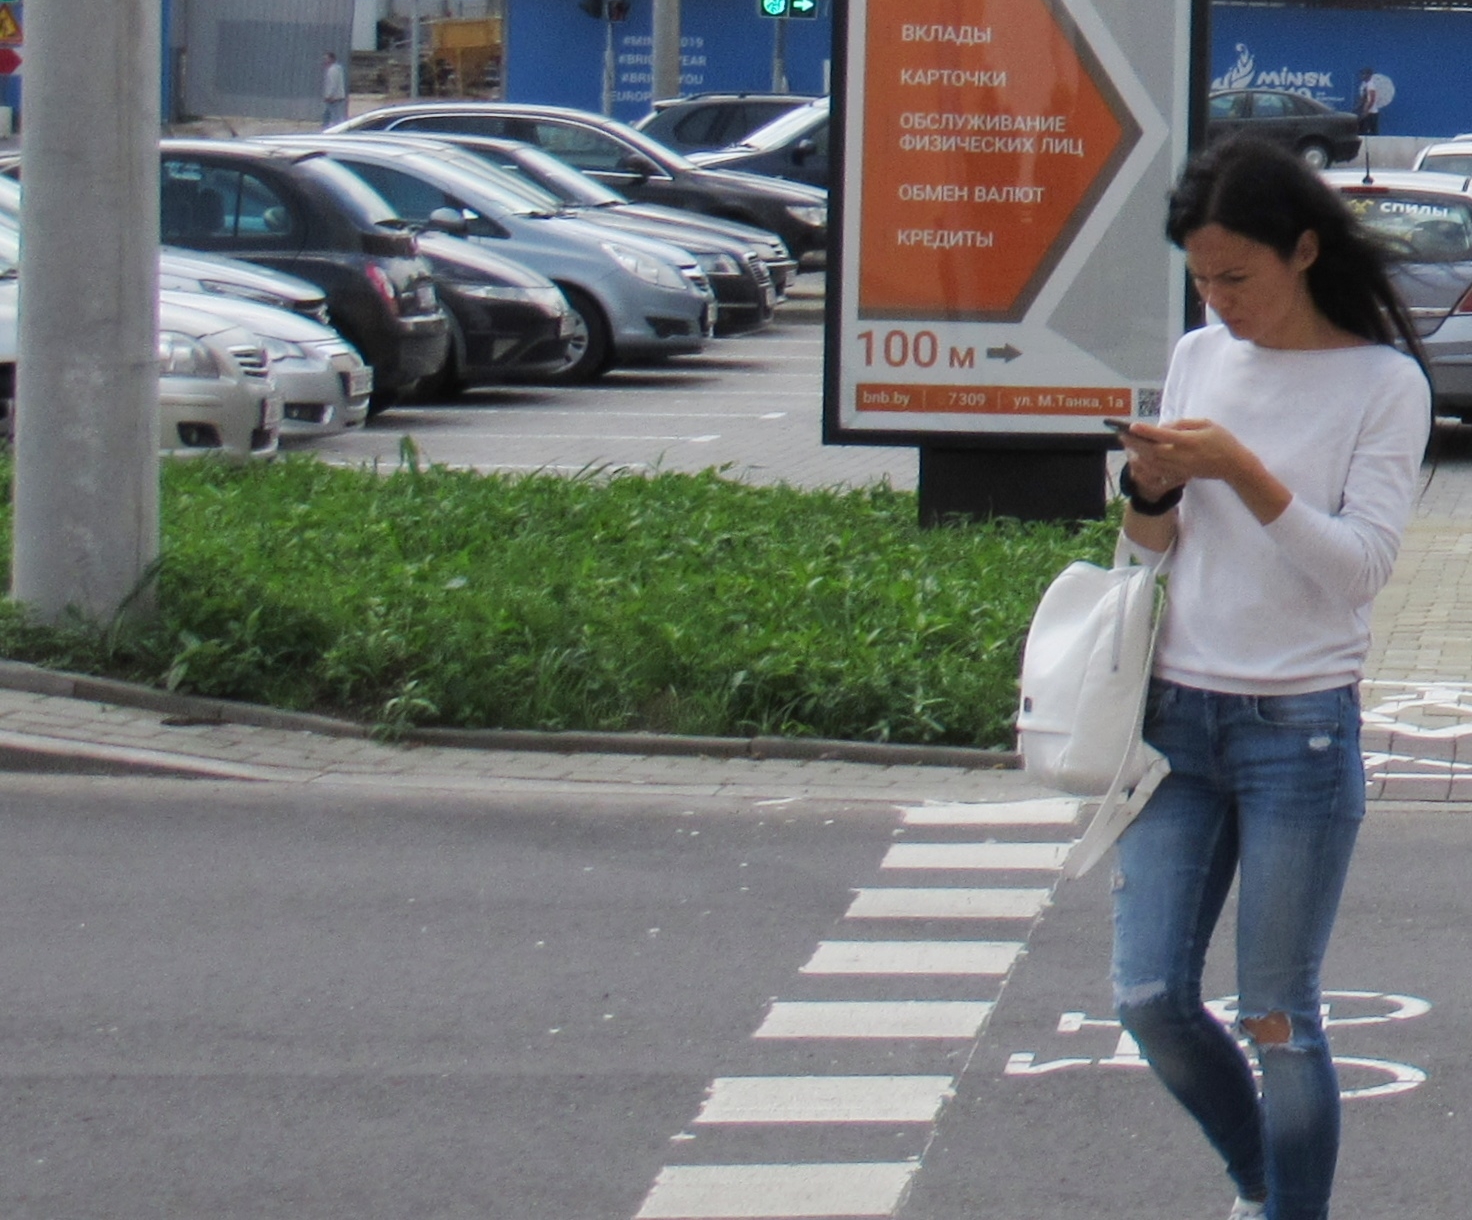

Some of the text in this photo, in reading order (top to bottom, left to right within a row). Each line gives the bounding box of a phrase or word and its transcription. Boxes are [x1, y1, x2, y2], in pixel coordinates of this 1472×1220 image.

[901, 25, 991, 45] ВКЛАДЫ
[900, 69, 1007, 87] КАРТОЧКИ
[1256, 67, 1333, 88] MINSK
[899, 112, 1067, 132] ОБСЛУЖИВАНИЕ
[899, 135, 1085, 158] ФИЗИЧЕСКИХ ЛИЦ
[898, 184, 1045, 204] ОБМЕН ВАЛЮТ
[897, 229, 994, 249] КРЕДИТЫ
[856, 330, 938, 368] 100
[863, 390, 911, 406] bnb.by
[947, 392, 987, 407] 7309
[1013, 397, 1039, 408] ул.
